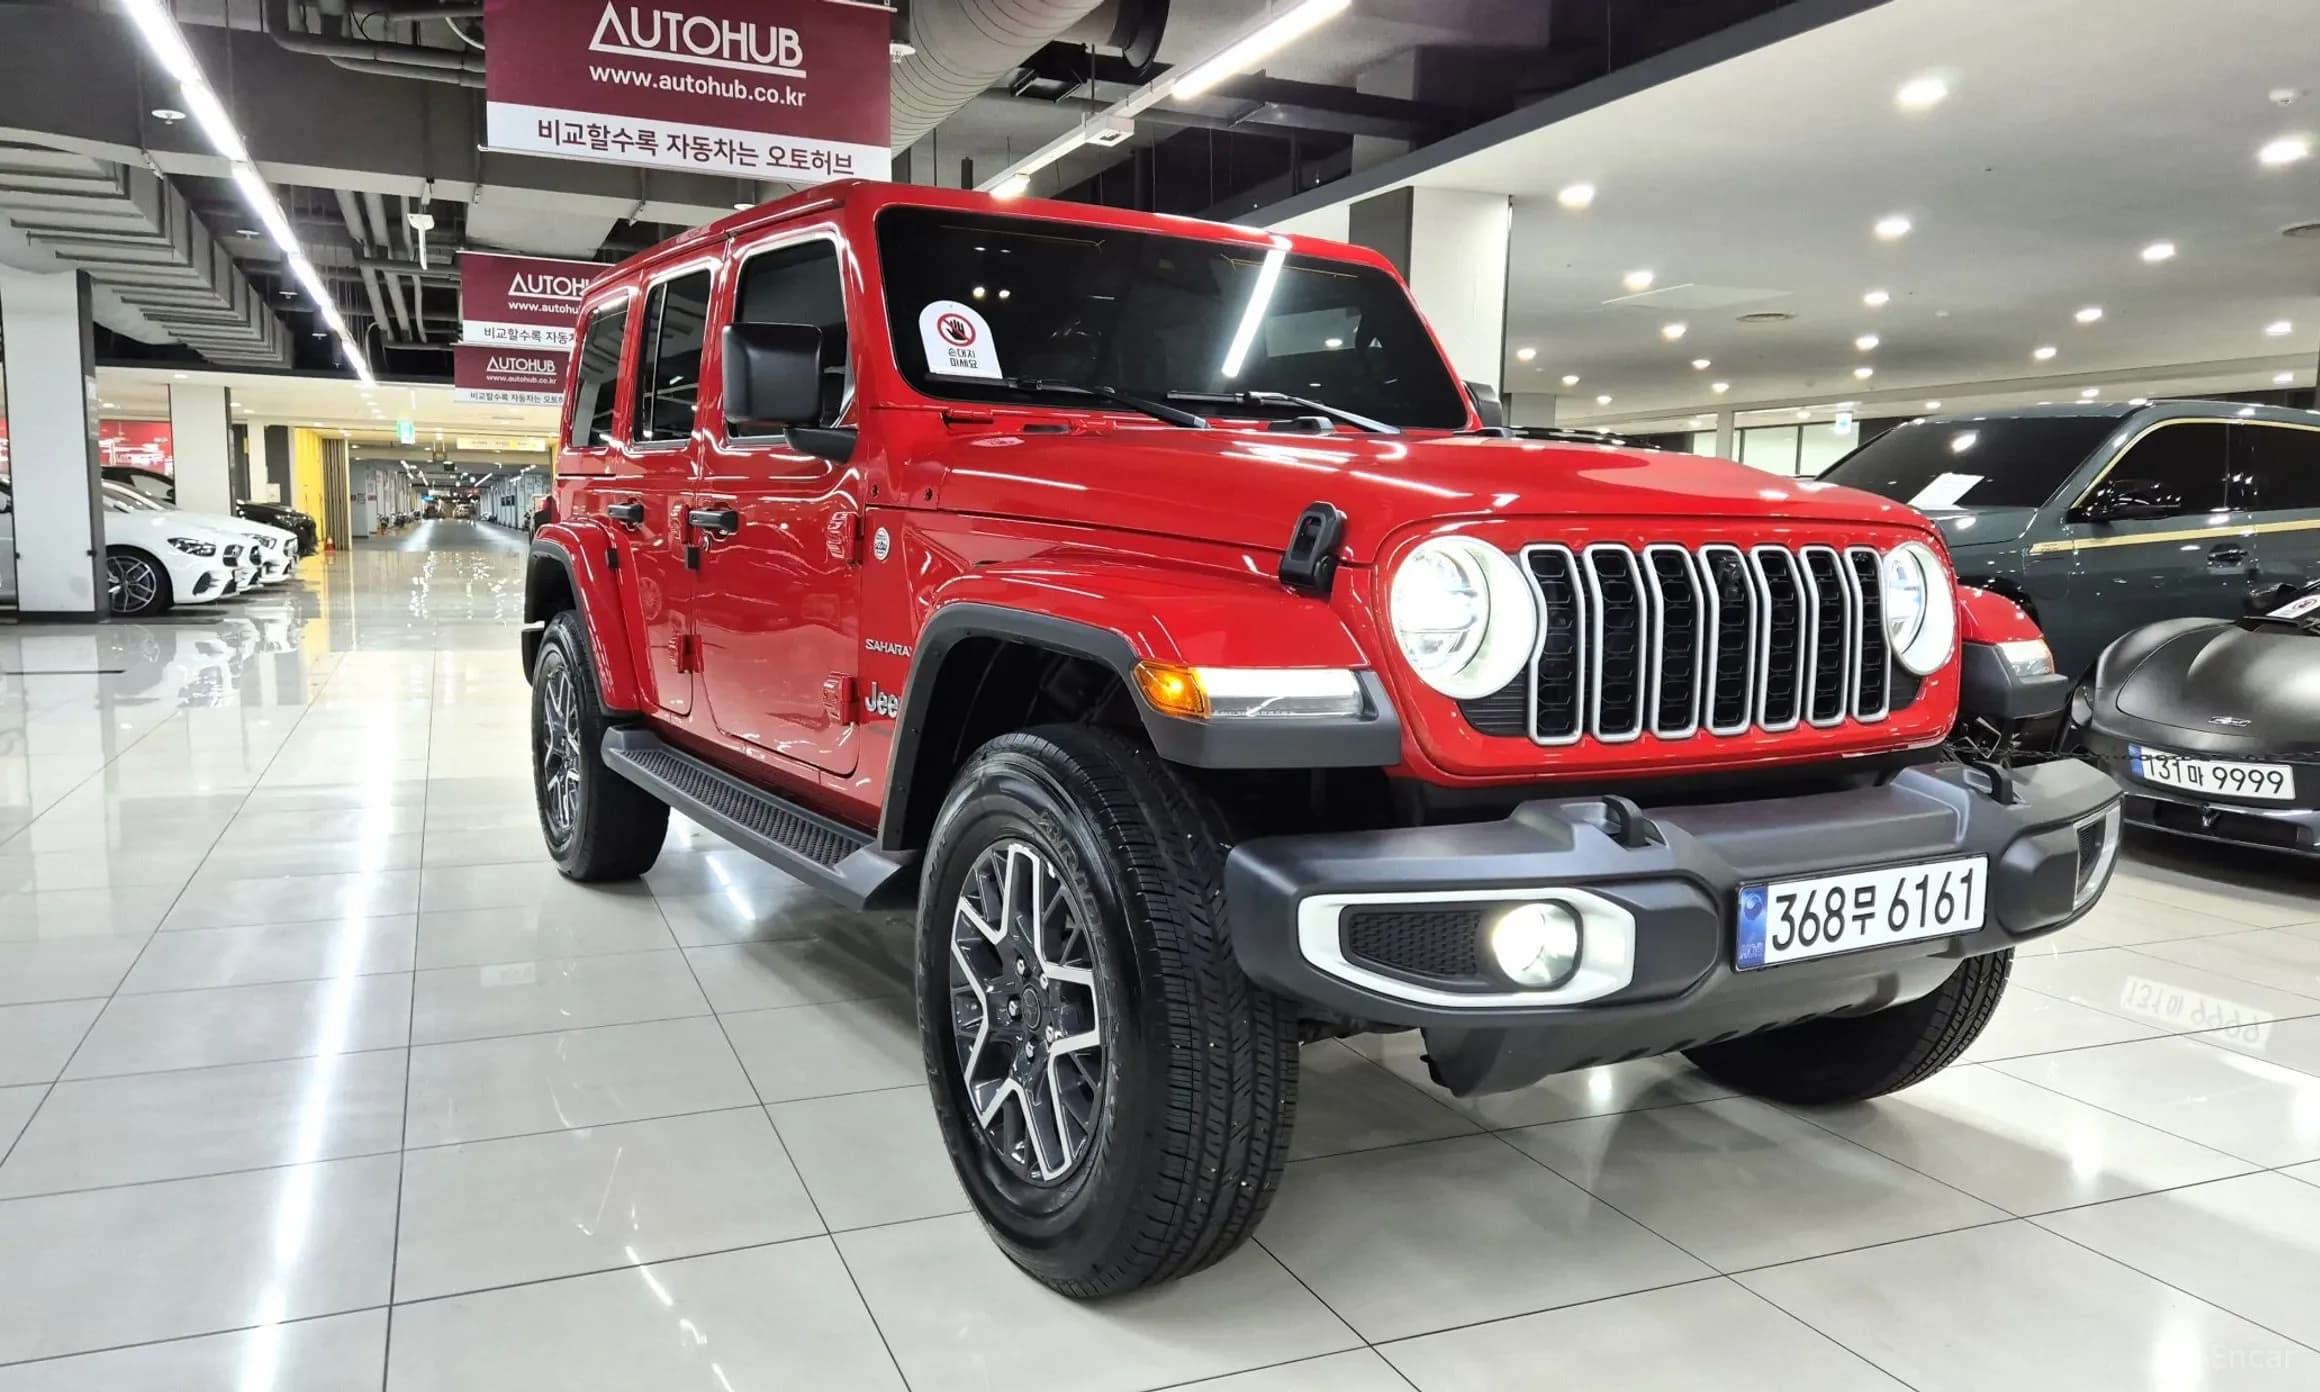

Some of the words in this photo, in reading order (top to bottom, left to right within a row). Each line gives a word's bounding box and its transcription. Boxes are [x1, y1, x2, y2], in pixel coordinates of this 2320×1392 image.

[588, 1, 806, 76] AUTOHUB
[588, 64, 807, 108] www.autohub.co.kr
[537, 118, 659, 156] 비교할수록
[666, 130, 760, 167] 자동차는
[765, 143, 855, 177] 오토허브
[508, 300, 582, 315] www.autohu
[483, 326, 542, 342] 비교할수록
[486, 356, 557, 375] AUTOHUB
[486, 374, 557, 385] www.autohub.co.kr
[865, 638, 911, 657] SAHARA
[865, 681, 901, 719] Jee
[2212, 766, 2284, 794] 9999
[1771, 885, 1876, 951] 368무
[1887, 867, 1974, 933] 6161
